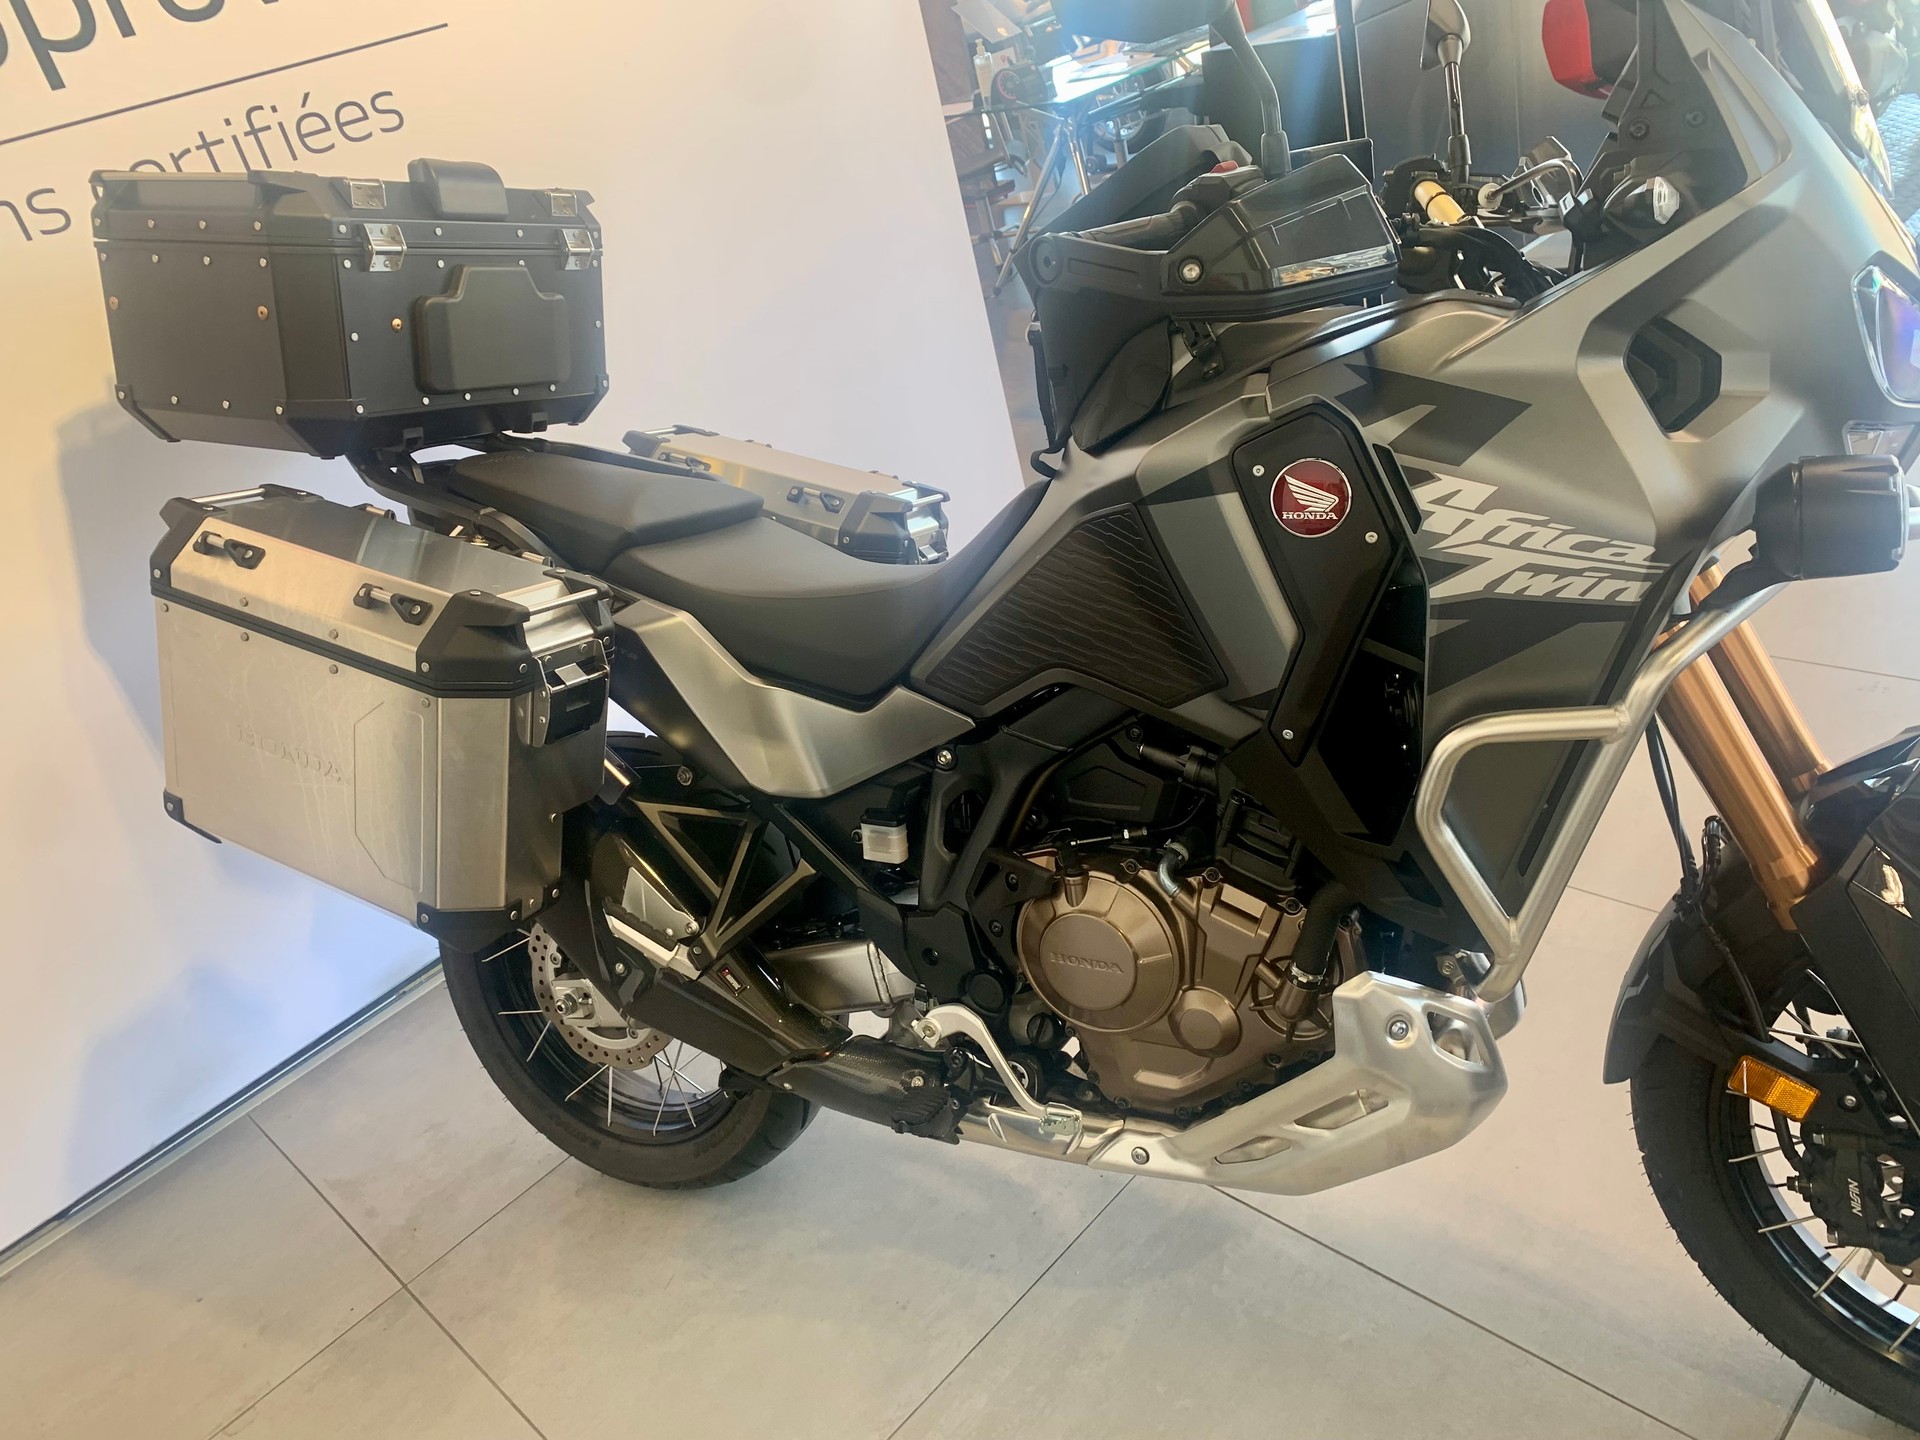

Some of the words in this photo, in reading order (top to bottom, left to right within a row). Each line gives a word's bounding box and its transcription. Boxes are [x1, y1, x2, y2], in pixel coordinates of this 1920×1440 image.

[93, 90, 405, 200] rtifiées
[1281, 511, 1339, 521] HONDA
[1411, 472, 1670, 568] Africa
[1429, 543, 1665, 602] Twin
[1051, 952, 1124, 974] HONDA
[1847, 1178, 1863, 1217] NISSIN
